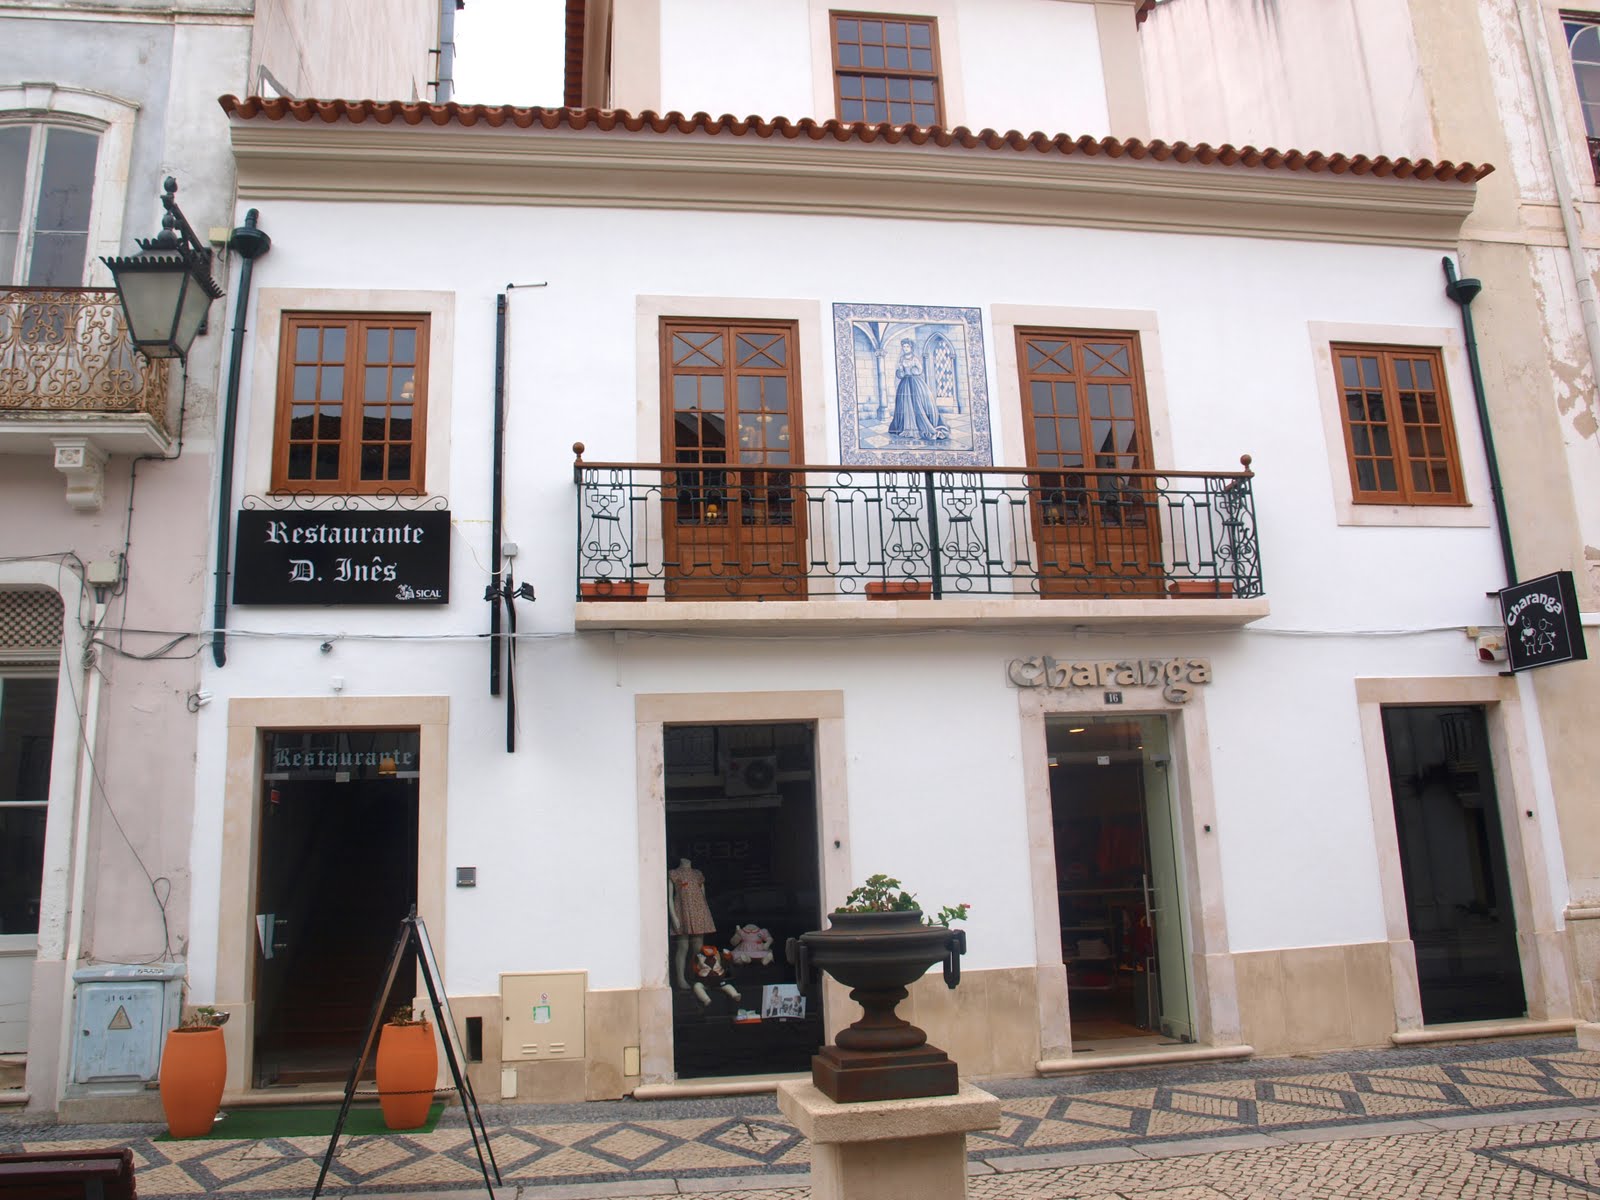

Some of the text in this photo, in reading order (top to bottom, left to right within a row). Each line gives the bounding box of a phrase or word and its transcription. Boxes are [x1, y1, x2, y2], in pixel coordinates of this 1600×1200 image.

[264, 521, 424, 545] Restaurante
[288, 555, 398, 582] D. Inês
[415, 589, 442, 598] SICAL
[1507, 593, 1562, 626] Charanga
[1008, 655, 1212, 703] Charanga
[1108, 693, 1119, 703] 16
